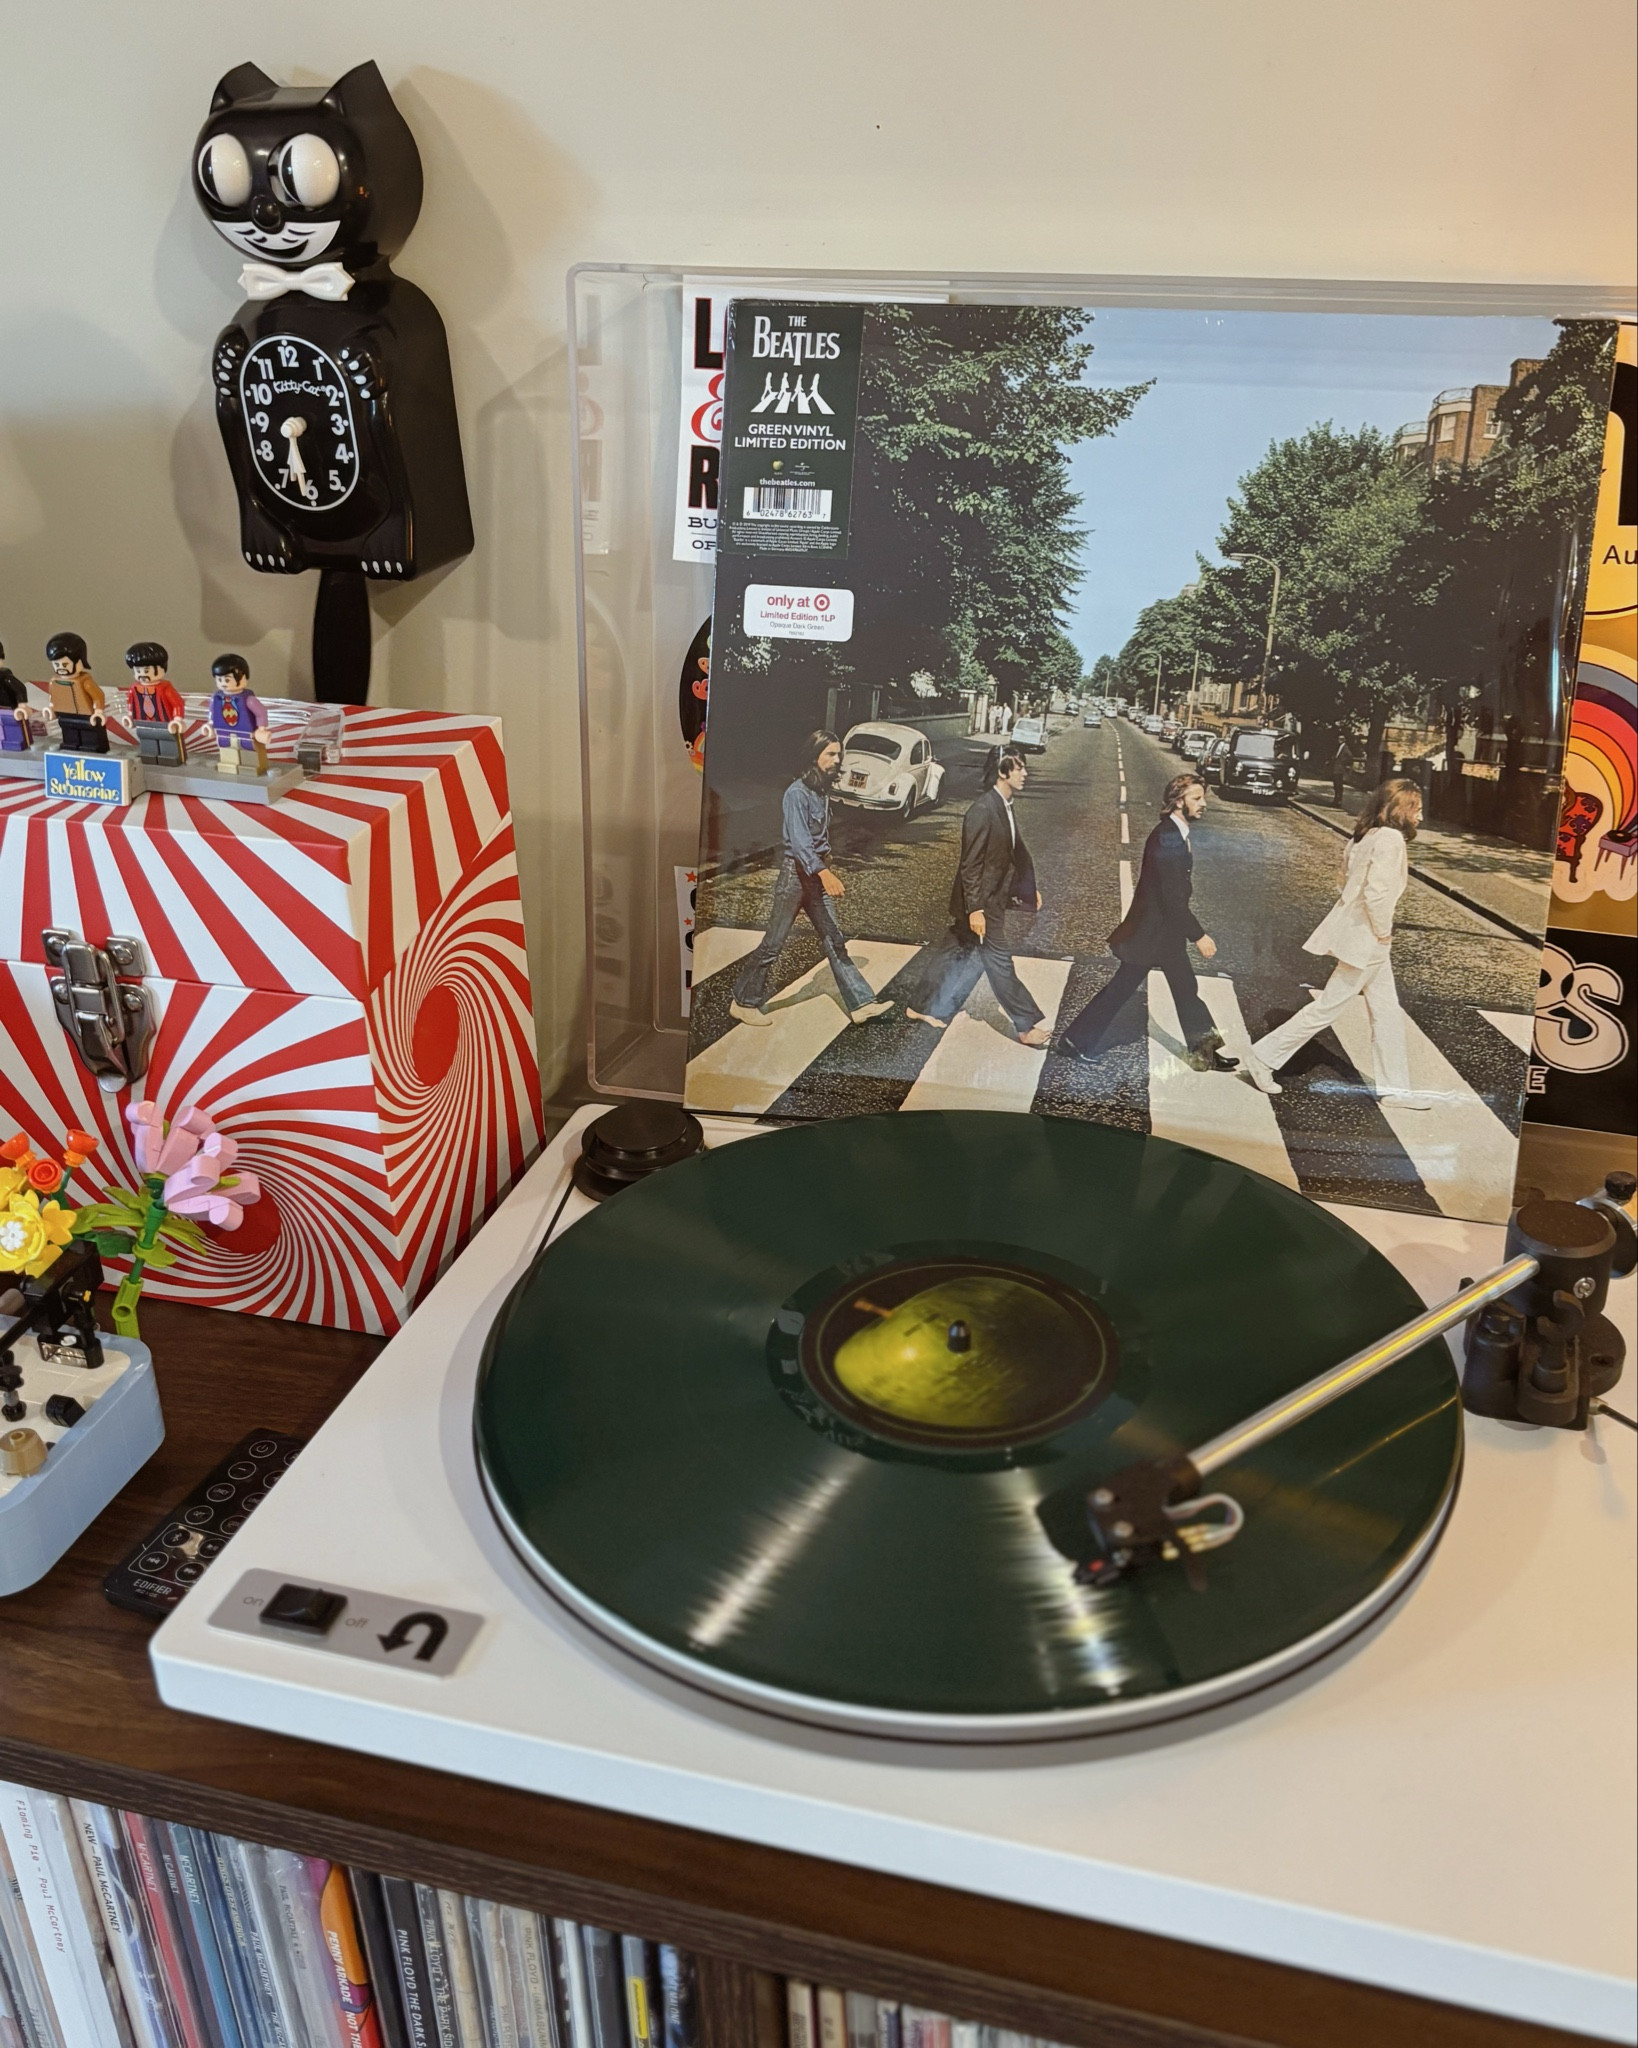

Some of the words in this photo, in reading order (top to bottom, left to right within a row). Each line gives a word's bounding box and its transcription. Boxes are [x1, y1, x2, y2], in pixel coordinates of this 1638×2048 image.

[788, 315, 808, 327] THE
[752, 315, 841, 366] BEATLES
[277, 345, 299, 368] 12
[257, 358, 274, 380] 11
[312, 359, 322, 381] 1
[250, 383, 273, 406] 10
[324, 384, 340, 407] 2
[254, 411, 270, 433] 9
[330, 413, 345, 436] 3
[748, 423, 793, 436] GREEN
[793, 424, 834, 438] VINYL
[261, 439, 275, 462] 8
[334, 442, 349, 464] 4
[734, 436, 787, 450] LIMITED
[789, 439, 847, 451] EDITION
[277, 468, 290, 489] 7
[328, 469, 341, 490] 5
[759, 477, 816, 488] thebeatles.com
[304, 479, 319, 501] 6
[767, 595, 795, 610] only
[797, 597, 810, 608] at
[760, 611, 789, 620] Limited
[791, 613, 818, 622] Edition
[62, 759, 106, 782] Yellow
[50, 777, 120, 801] Submarine
[133, 1578, 173, 1595] EDIFIER
[243, 1596, 264, 1606] on
[345, 1617, 368, 1628] off
[16, 1799, 33, 1839] Flaming
[83, 1822, 97, 1846] NEW
[28, 1845, 40, 1862] Pie
[92, 1855, 107, 1881] PAUL
[38, 1877, 53, 1899] Paul
[98, 1879, 122, 1934] McCARTNEY
[44, 1904, 66, 1953] McCartney
[396, 1927, 411, 1954] PINK
[401, 1954, 417, 1990] FLOYD
[424, 1917, 437, 1940] PINK
[437, 2004, 451, 2030] DARK
[526, 1951, 538, 1984] FLOYD
[327, 1930, 343, 1965] PENNY
[335, 1963, 353, 2004] ARKADE
[345, 2010, 358, 2031] NOT
[408, 1990, 422, 2011] THE
[411, 2011, 426, 2039] DARK
